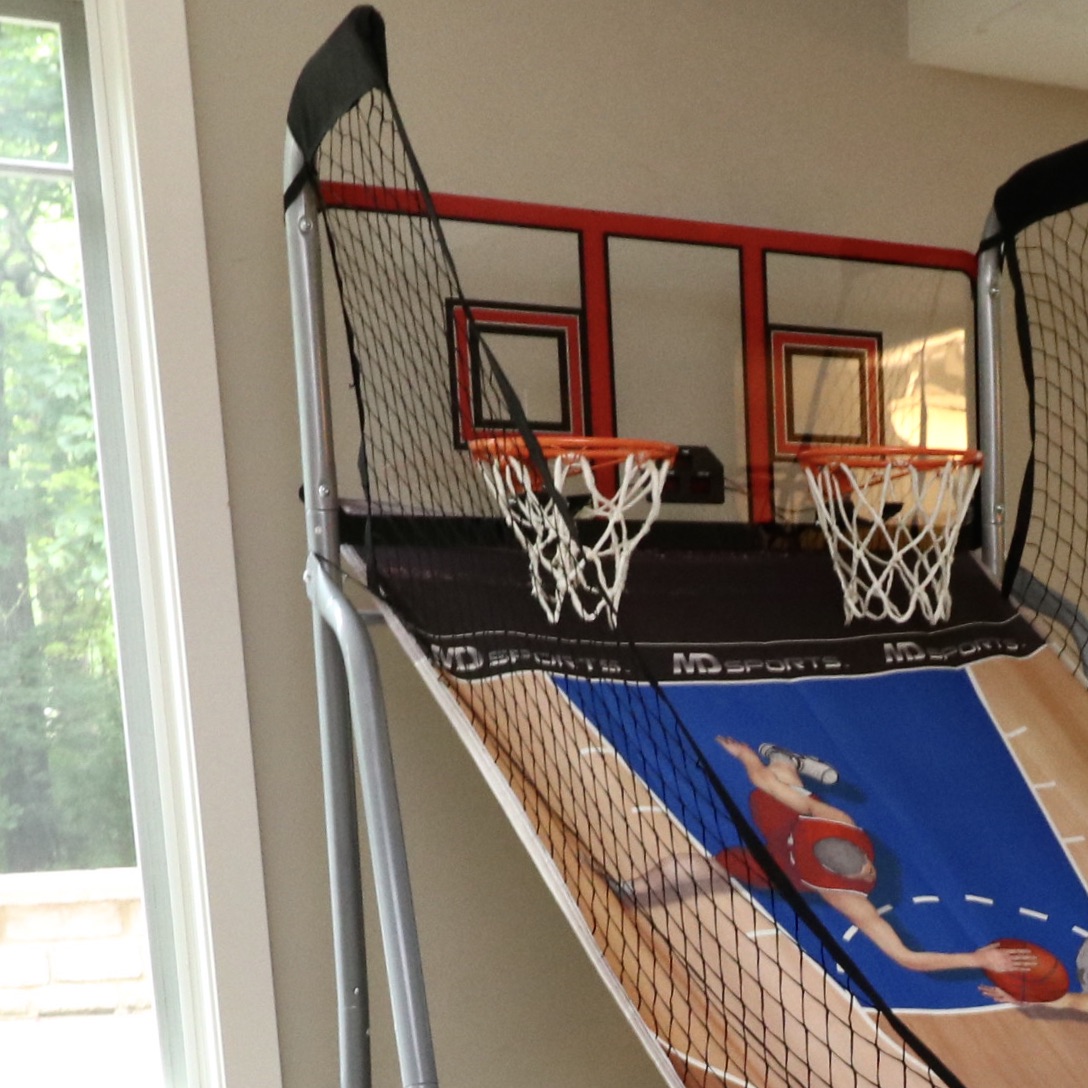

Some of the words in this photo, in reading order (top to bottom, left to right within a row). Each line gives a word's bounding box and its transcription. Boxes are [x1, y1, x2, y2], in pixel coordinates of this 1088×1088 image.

[430, 643, 484, 671] MD
[673, 652, 722, 674] MD
[724, 656, 842, 674] SPORTS
[883, 641, 926, 664] MD
